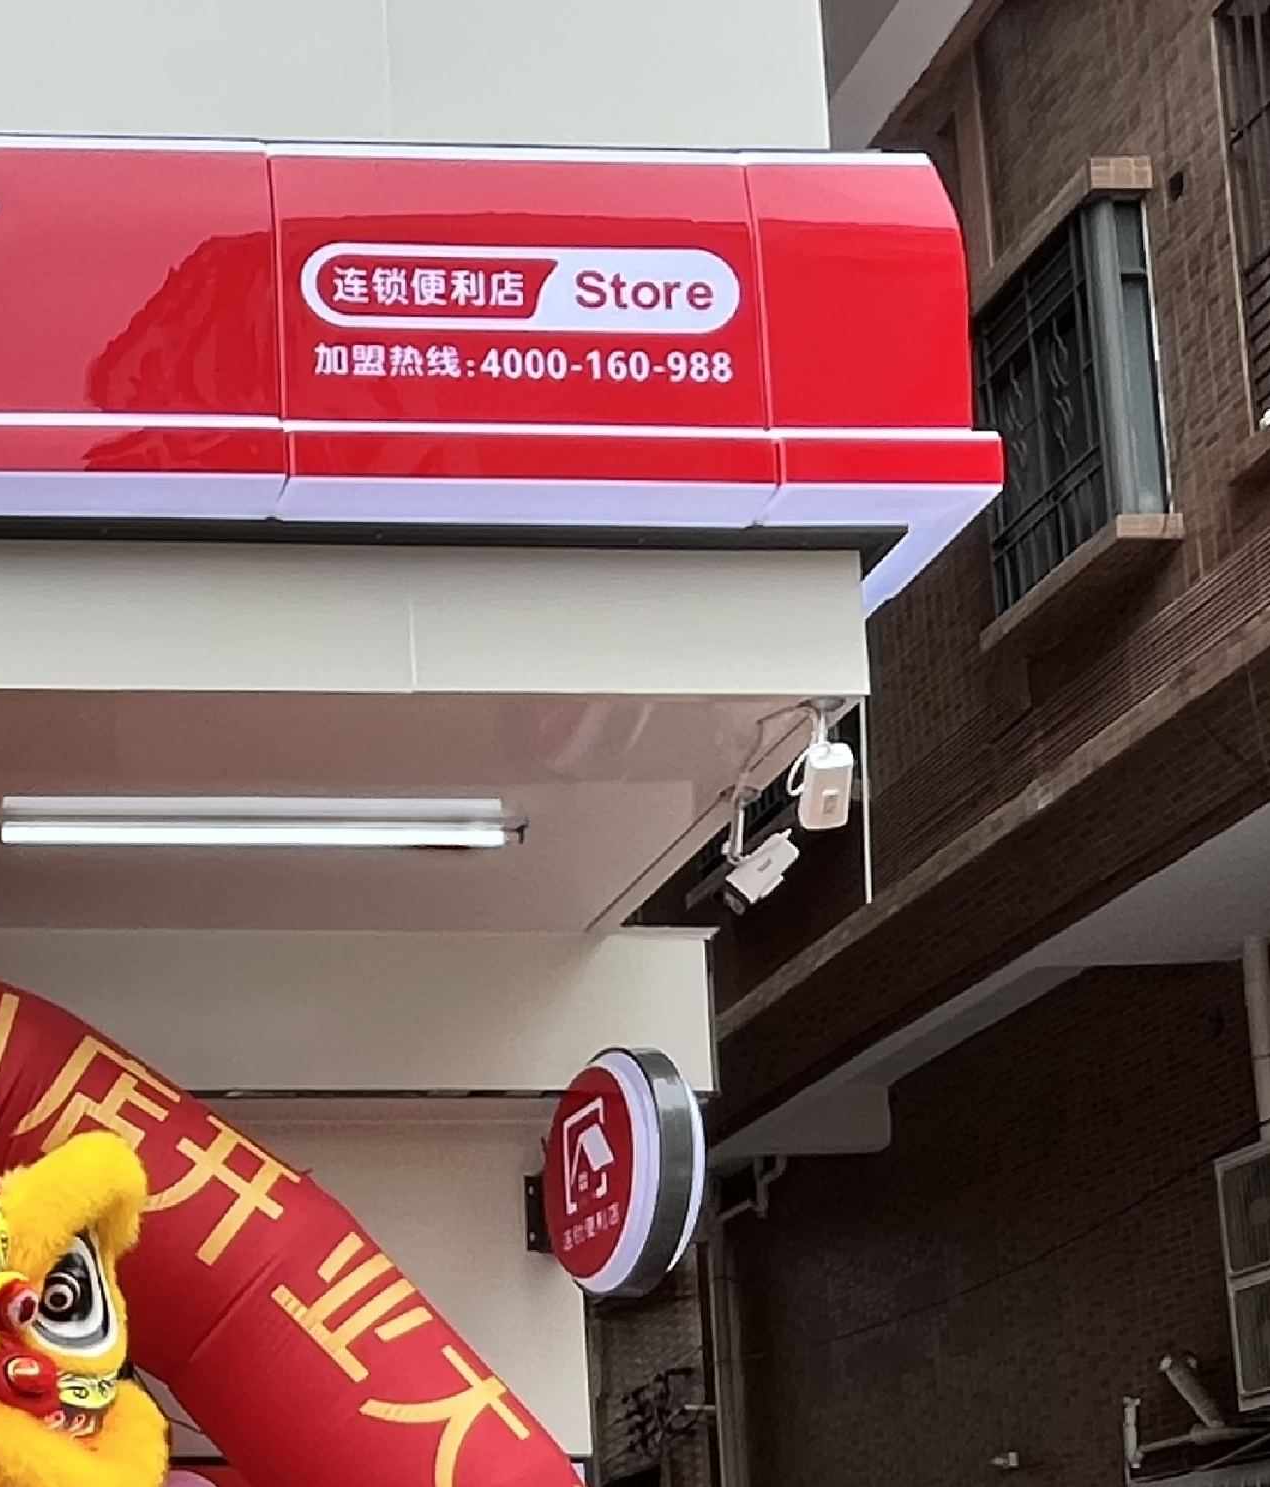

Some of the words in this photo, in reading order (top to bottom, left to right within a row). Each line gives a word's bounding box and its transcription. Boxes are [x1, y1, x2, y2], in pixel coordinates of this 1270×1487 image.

[332, 267, 525, 307] 连锁便利店
[575, 270, 715, 311] Store
